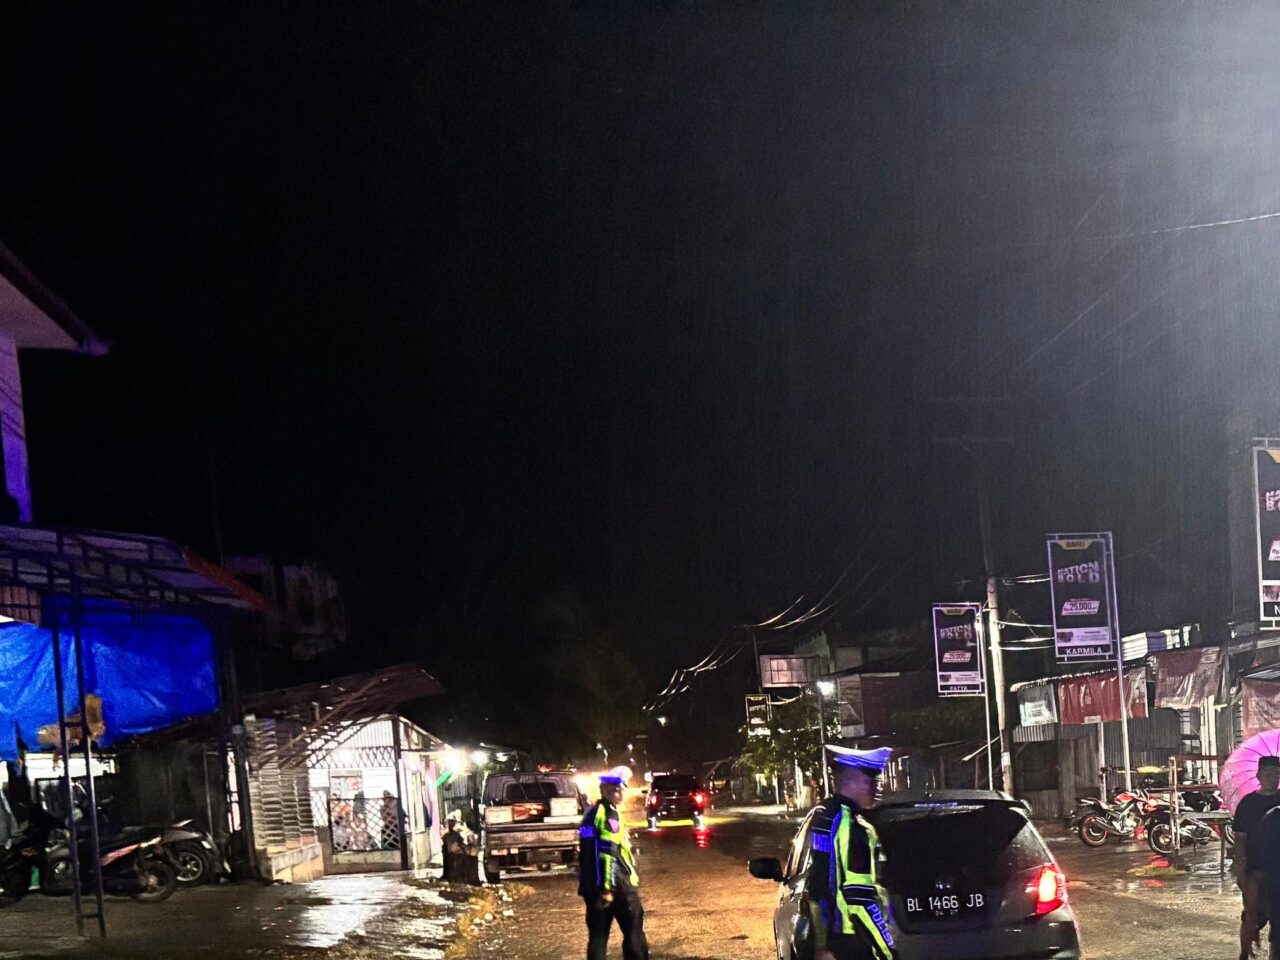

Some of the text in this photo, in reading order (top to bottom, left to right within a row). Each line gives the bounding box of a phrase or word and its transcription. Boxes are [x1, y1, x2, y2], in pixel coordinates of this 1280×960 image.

[907, 893, 984, 912] BL 1466 JB
